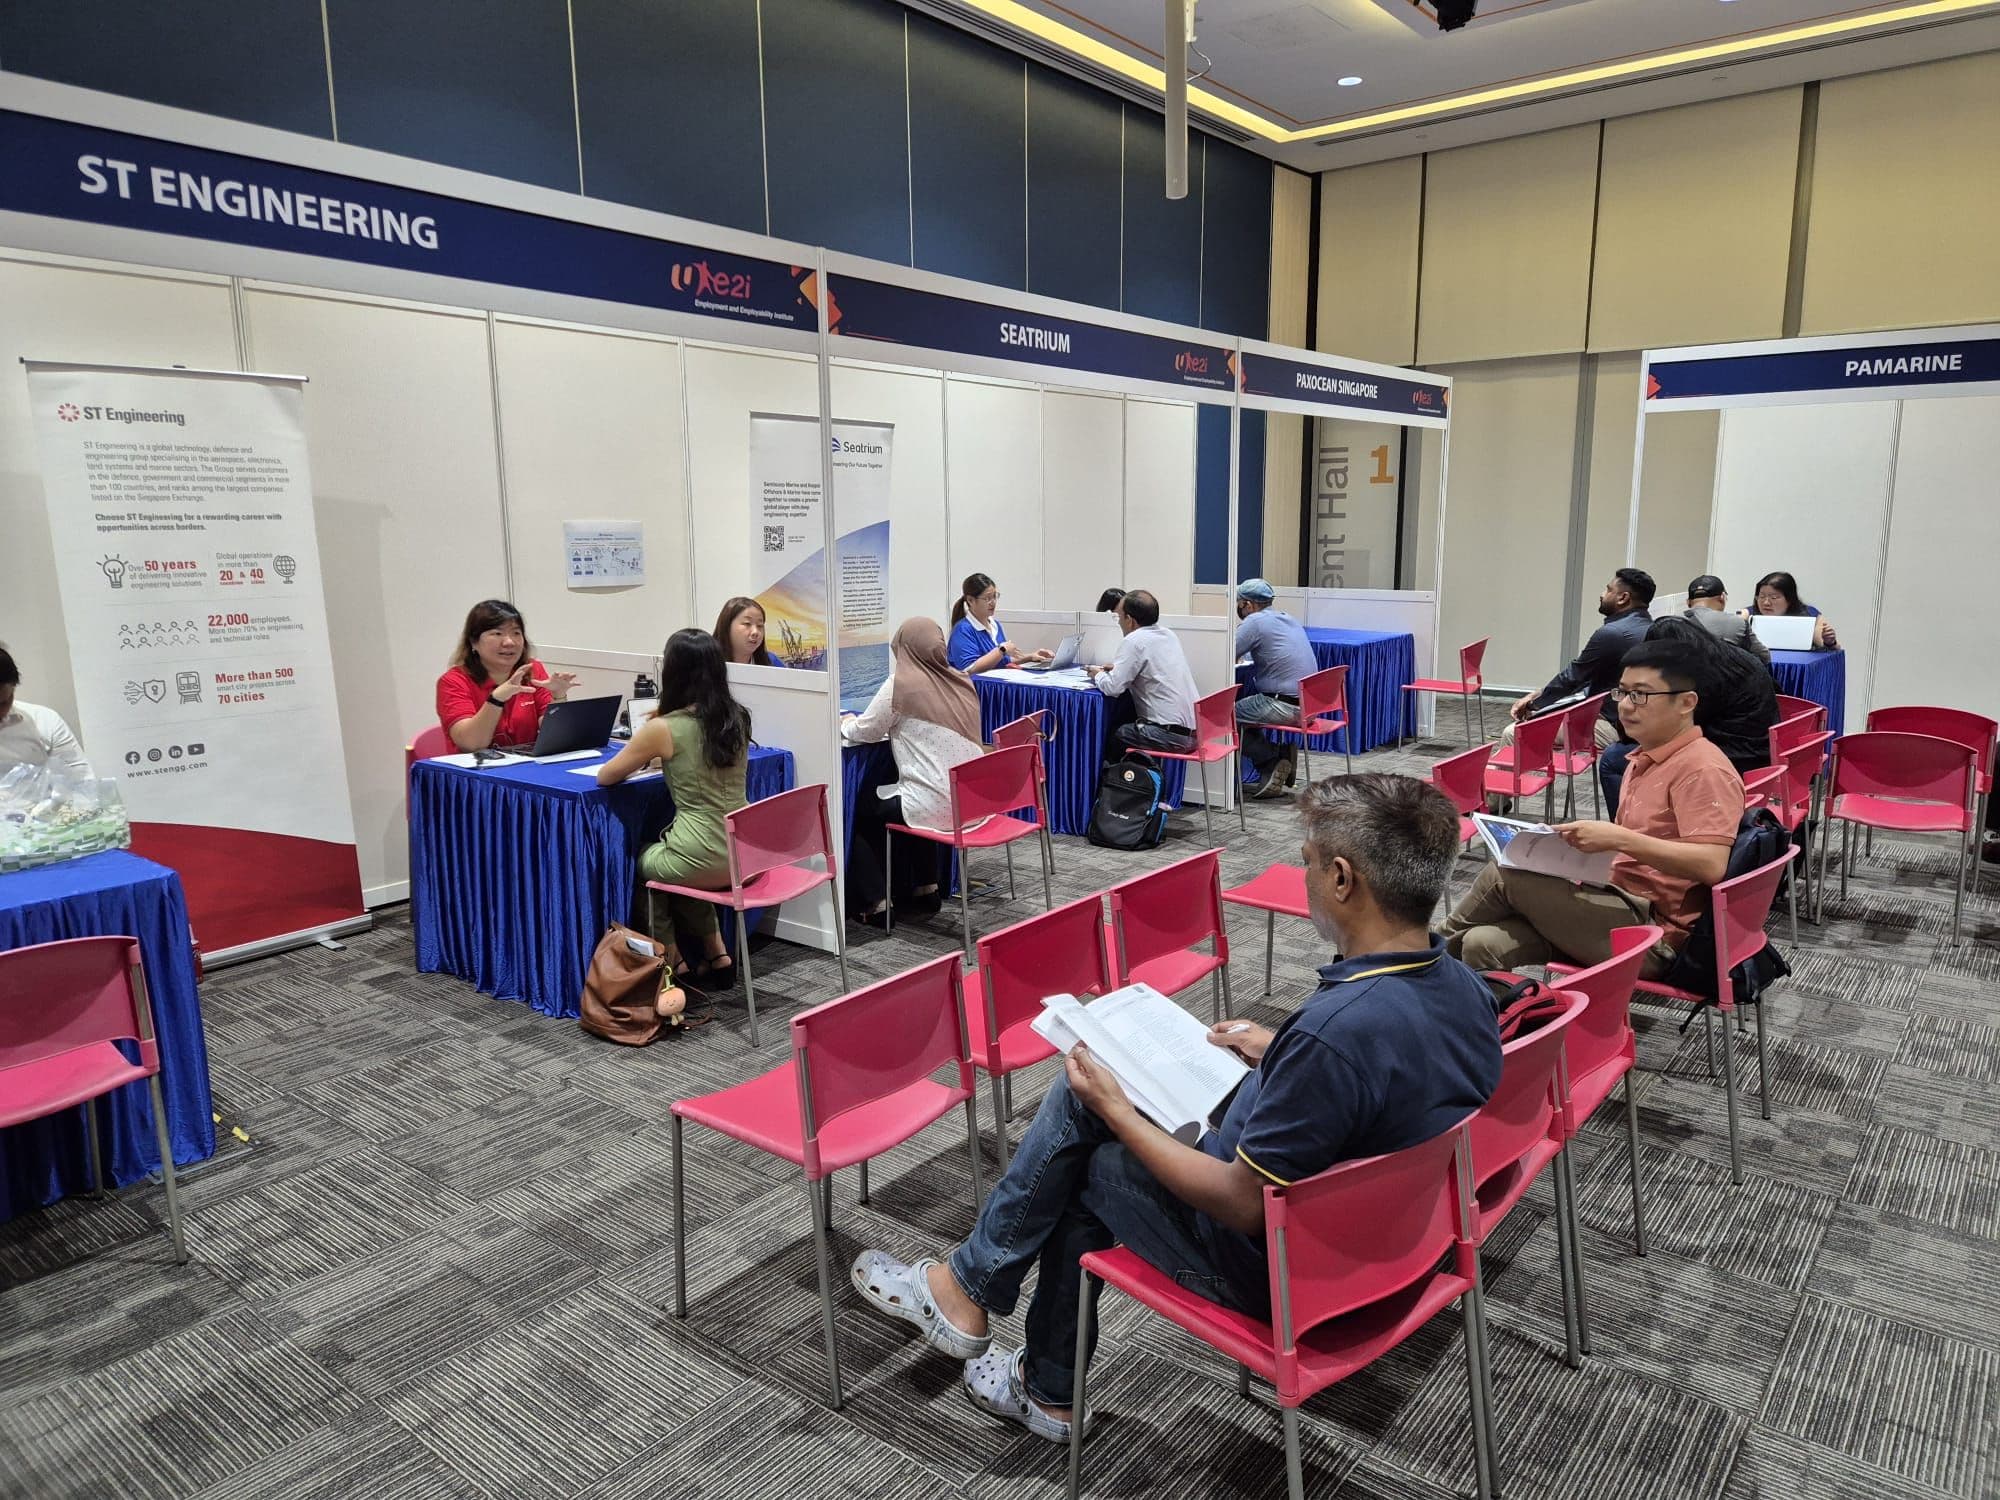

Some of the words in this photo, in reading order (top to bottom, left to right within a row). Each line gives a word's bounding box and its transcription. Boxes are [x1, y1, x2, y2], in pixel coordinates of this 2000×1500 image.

[77, 154, 137, 200] ST
[150, 166, 439, 249] ENGINEERING
[694, 299, 729, 312] Employment
[728, 303, 740, 313] and
[740, 304, 774, 320] Employability
[774, 311, 795, 322] Institute
[1000, 322, 1071, 354] SEATRIUM
[1845, 354, 1963, 377] PAMARINE
[1296, 372, 1338, 393] PAXOCEAN
[1338, 379, 1378, 399] SINGAPORE
[83, 406, 102, 420] ST
[106, 407, 185, 426] Engineering
[96, 442, 138, 452] Engineering
[843, 441, 883, 454] Seatrium
[1369, 444, 1395, 484] 1
[1317, 446, 1349, 519] Hall
[95, 513, 126, 521] Choose
[126, 513, 138, 521] ST
[138, 513, 184, 523] Engineering
[96, 523, 149, 533] opportunities
[216, 552, 237, 561] Global
[1317, 534, 1346, 589] ent
[144, 560, 159, 572] 50
[161, 560, 197, 573] years
[219, 569, 233, 581] 20
[249, 567, 264, 579] 40
[130, 582, 171, 590] engineering
[207, 612, 249, 627] 22,000
[208, 627, 226, 635] More
[227, 626, 242, 634] than
[215, 672, 245, 684] More
[247, 670, 273, 681] than
[274, 667, 294, 679] 500
[217, 694, 231, 705] 70
[233, 692, 266, 703] cities
[127, 761, 209, 779] www.stengg.com
